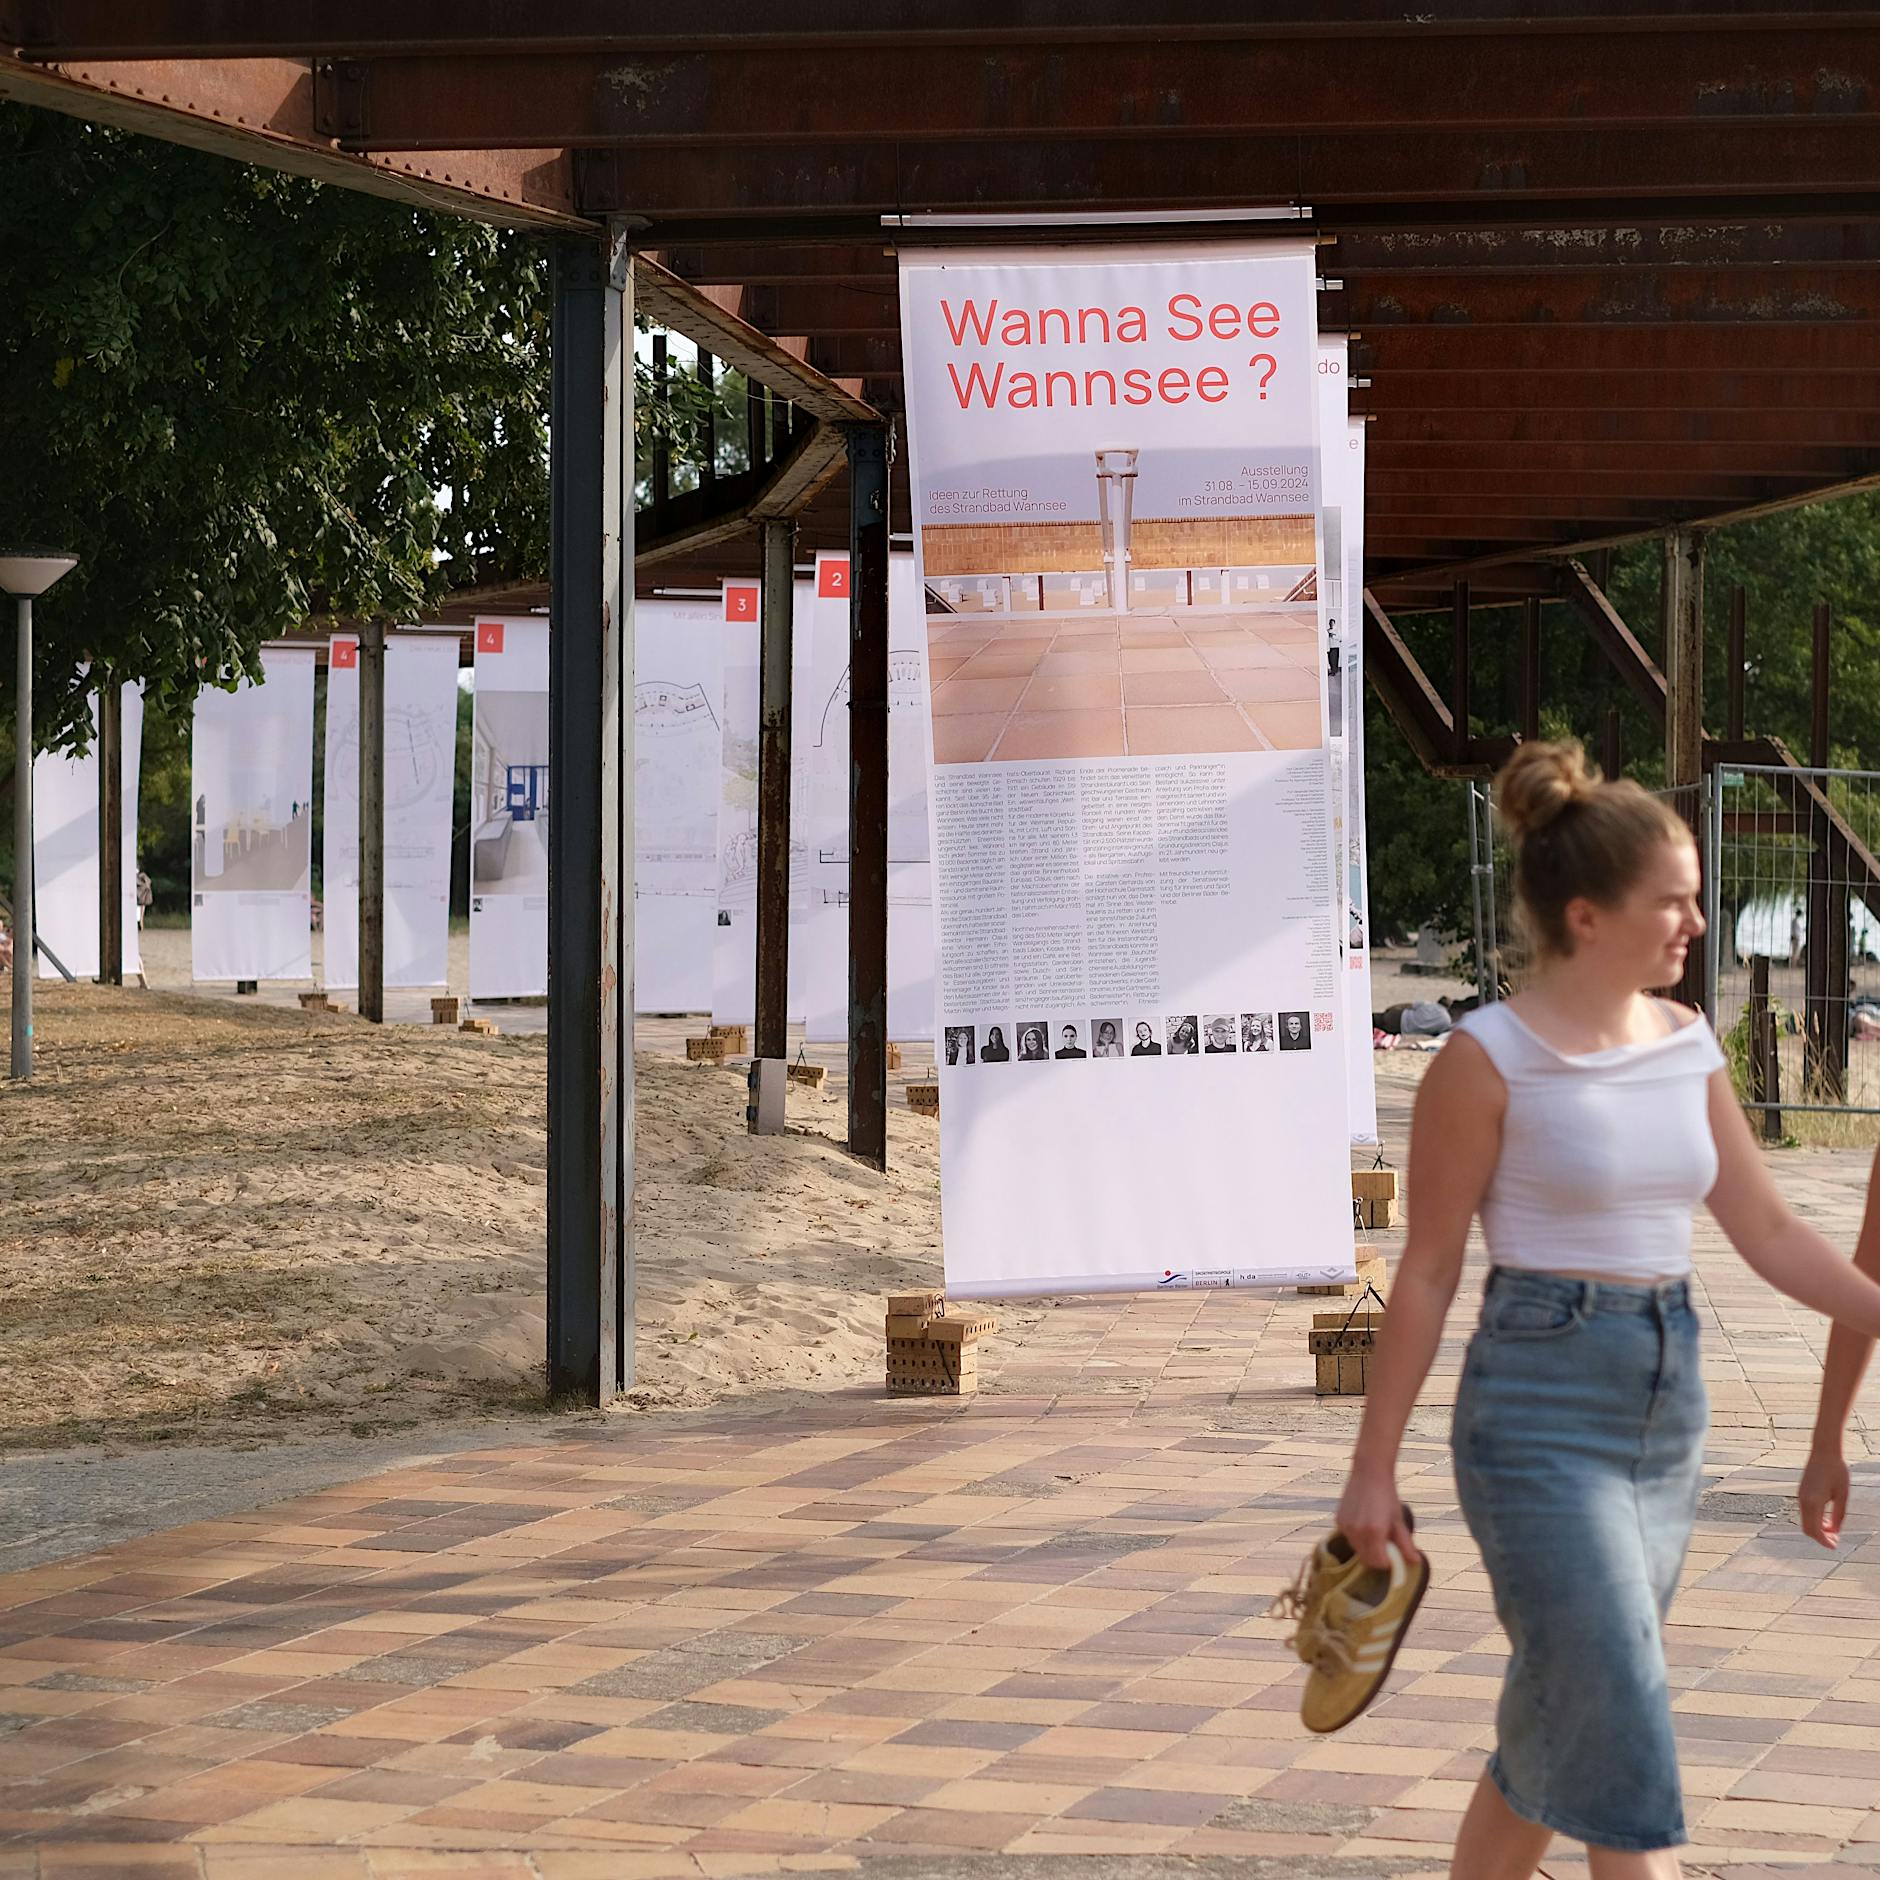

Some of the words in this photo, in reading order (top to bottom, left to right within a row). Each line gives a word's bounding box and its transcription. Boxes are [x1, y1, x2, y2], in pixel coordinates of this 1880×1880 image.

[941, 300, 1147, 346] Wanna
[1168, 294, 1280, 341] See
[1317, 359, 1340, 374] do
[947, 362, 1229, 408] Wannsee
[1250, 353, 1277, 400] ?
[1349, 439, 1359, 449] e
[1241, 465, 1308, 477] Ausstellung
[1248, 478, 1308, 490] 15.09.2024
[928, 490, 960, 500] Ideen
[962, 490, 979, 499] zur
[982, 488, 1028, 501] Rettung
[1178, 495, 1192, 506] im
[1194, 494, 1253, 506] Strandbad
[1255, 493, 1309, 503] Wannsee
[929, 504, 951, 514] des
[952, 502, 1011, 514] Strandbad
[1013, 501, 1067, 512] Wannsee
[831, 572, 842, 587] 2
[736, 598, 746, 612] 3
[486, 633, 494, 644] 4
[340, 651, 348, 661] 4
